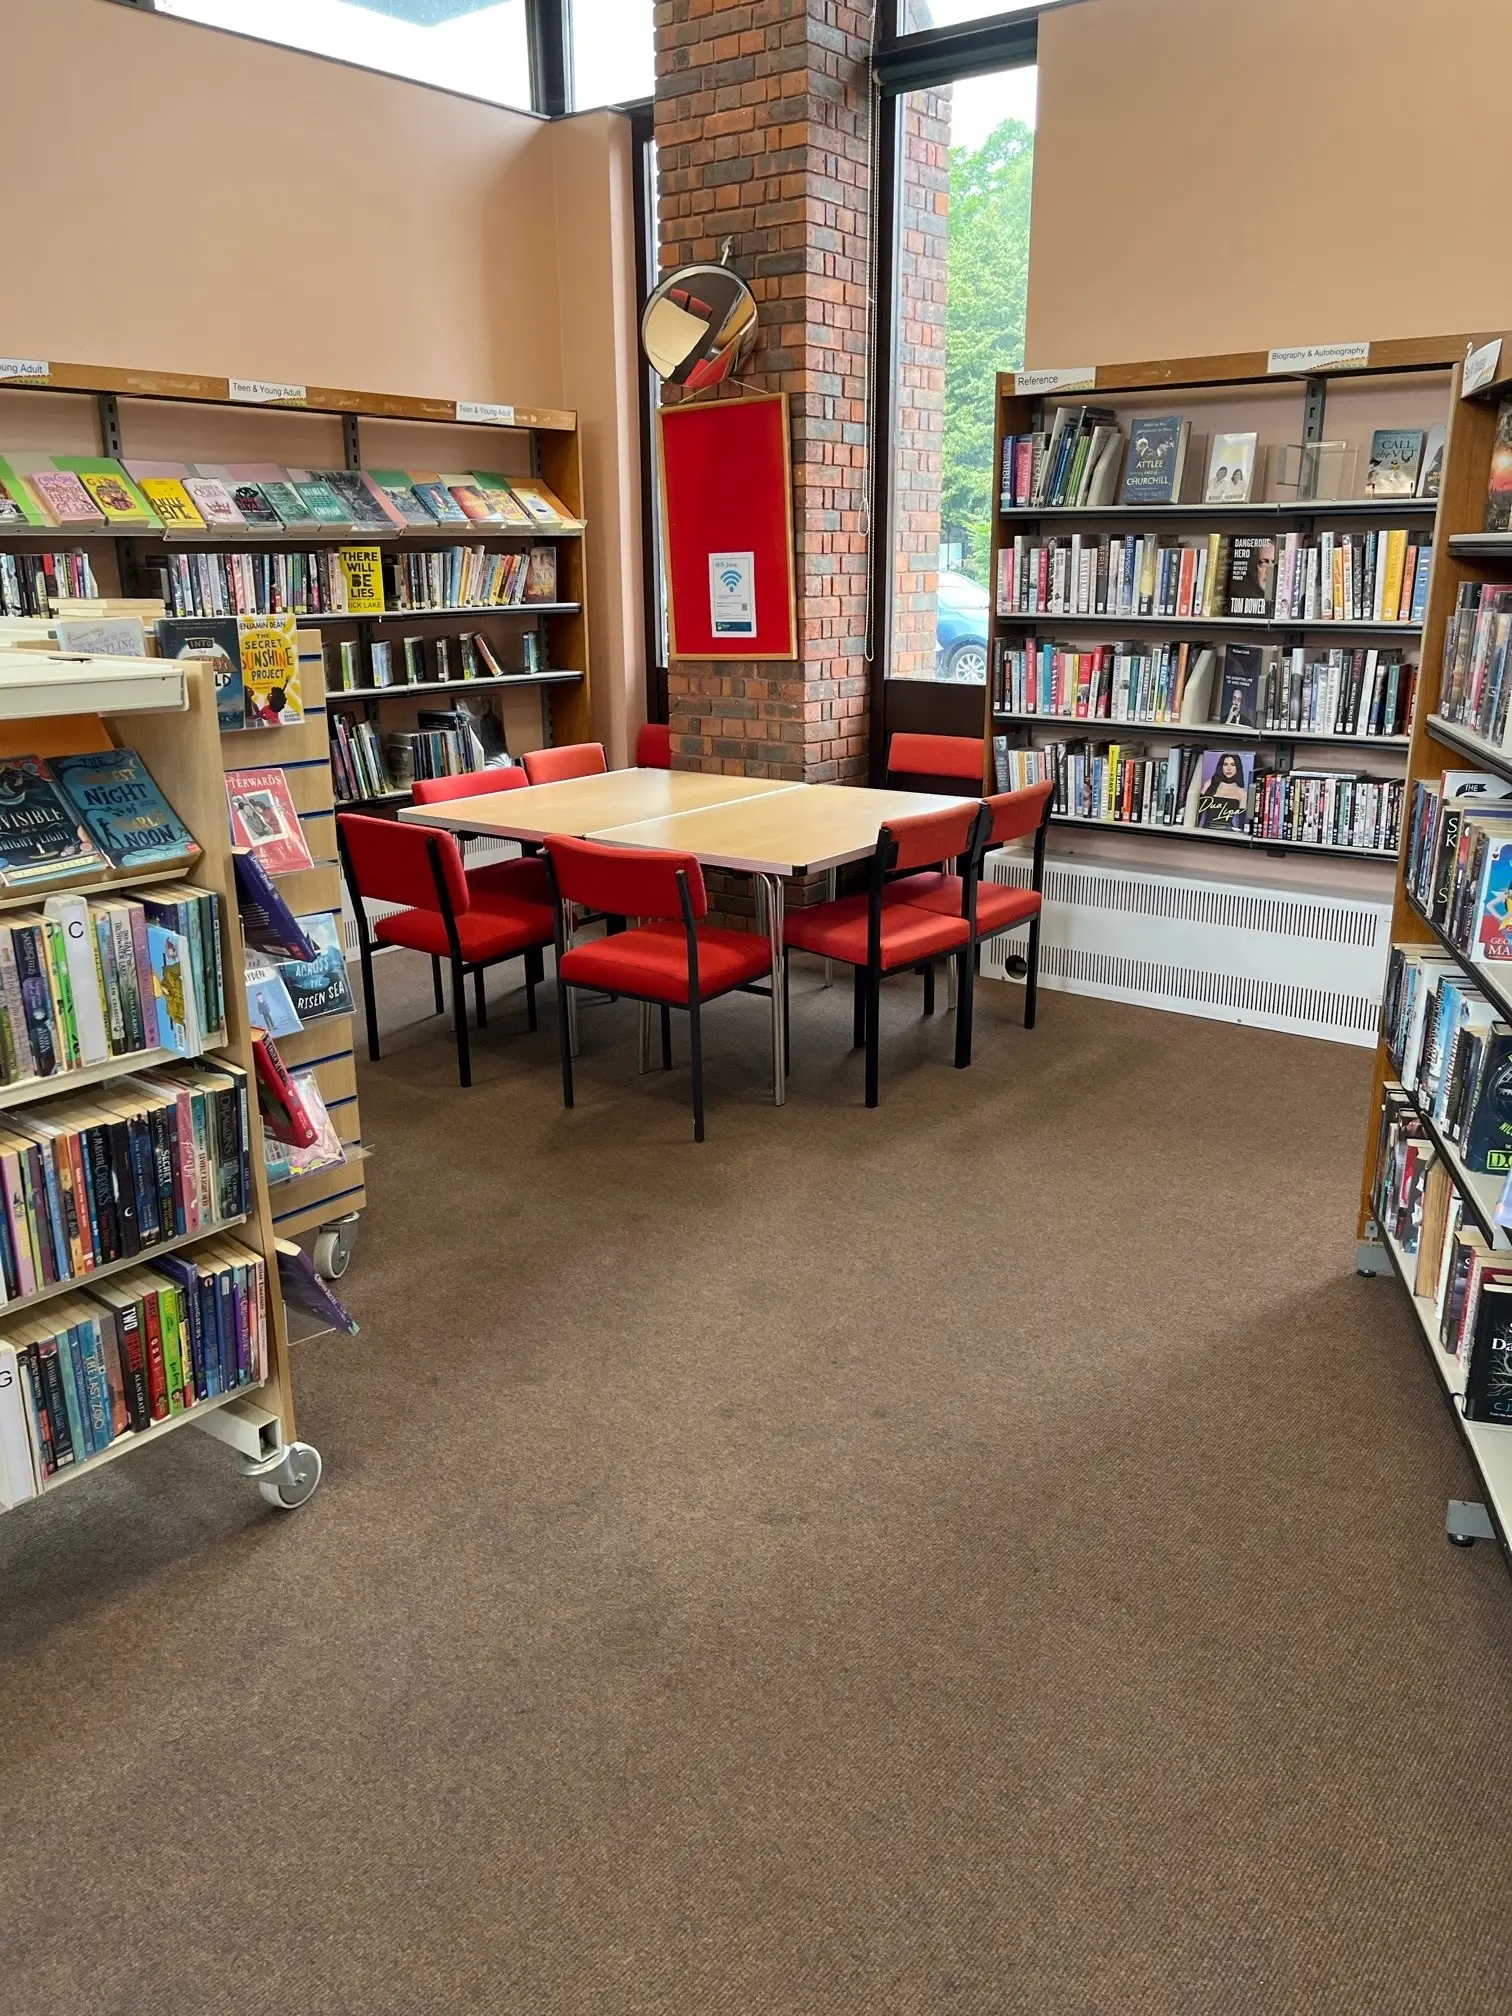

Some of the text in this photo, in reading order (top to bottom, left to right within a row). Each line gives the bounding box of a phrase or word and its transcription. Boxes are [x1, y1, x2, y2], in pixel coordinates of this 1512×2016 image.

[1272, 350, 1306, 360] Biography
[1314, 347, 1365, 358] Autobiography
[20, 364, 43, 373] Adult
[1018, 376, 1058, 386] Reference
[232, 383, 301, 397] Teen & Young Adult
[459, 404, 511, 417] Teen & Young Adult
[1382, 440, 1414, 450] CALL
[1376, 450, 1418, 459] the VET
[1136, 460, 1163, 469] ATTLEE
[1002, 460, 1010, 488] BIBLE
[1127, 476, 1169, 486] CHURCHILL
[159, 507, 197, 521] BIT
[1235, 538, 1272, 548] DANGEROUS
[341, 551, 378, 562] THERE
[1097, 545, 1105, 576] BERLIN
[1122, 535, 1133, 573] Bill Bryson
[1234, 549, 1250, 558] HERO
[347, 563, 374, 572] WILL
[351, 574, 372, 588] BE
[351, 588, 375, 598] LIES
[1231, 597, 1266, 614] TOM BOWER
[240, 621, 286, 630] ENJAMIN DEAN
[190, 640, 212, 648] INTO
[245, 639, 283, 650] SECRET
[241, 647, 293, 671] SUNSHINE
[1351, 652, 1362, 680] SIEGE
[251, 669, 285, 681] PROJECT
[1159, 666, 1167, 685] GAZZA
[1349, 682, 1357, 704] MICHAEL
[1464, 783, 1479, 792] THE
[1198, 796, 1222, 814] Dua
[1212, 801, 1245, 821] Lipa
[39, 830, 70, 844] LIGHT
[124, 825, 176, 847] NOON
[69, 921, 84, 939] C
[123, 941, 132, 956] TALE
[118, 960, 127, 978] LAKE
[295, 956, 329, 977] ACROSS
[310, 978, 323, 989] THE
[298, 981, 345, 1009] RISEN SEA
[129, 1008, 140, 1038] CARROLL
[218, 1094, 234, 1153] DRAGONS
[92, 1137, 104, 1166] MASTER
[155, 1155, 164, 1187] REAKERS
[160, 1149, 173, 1184] SECRET
[200, 1175, 209, 1192] RIGHT
[119, 1305, 139, 1331] TWO
[0, 1370, 13, 1388] G
[83, 1354, 105, 1429] THE LAST ZOO
[132, 1373, 146, 1414] ALAN GRATZ
